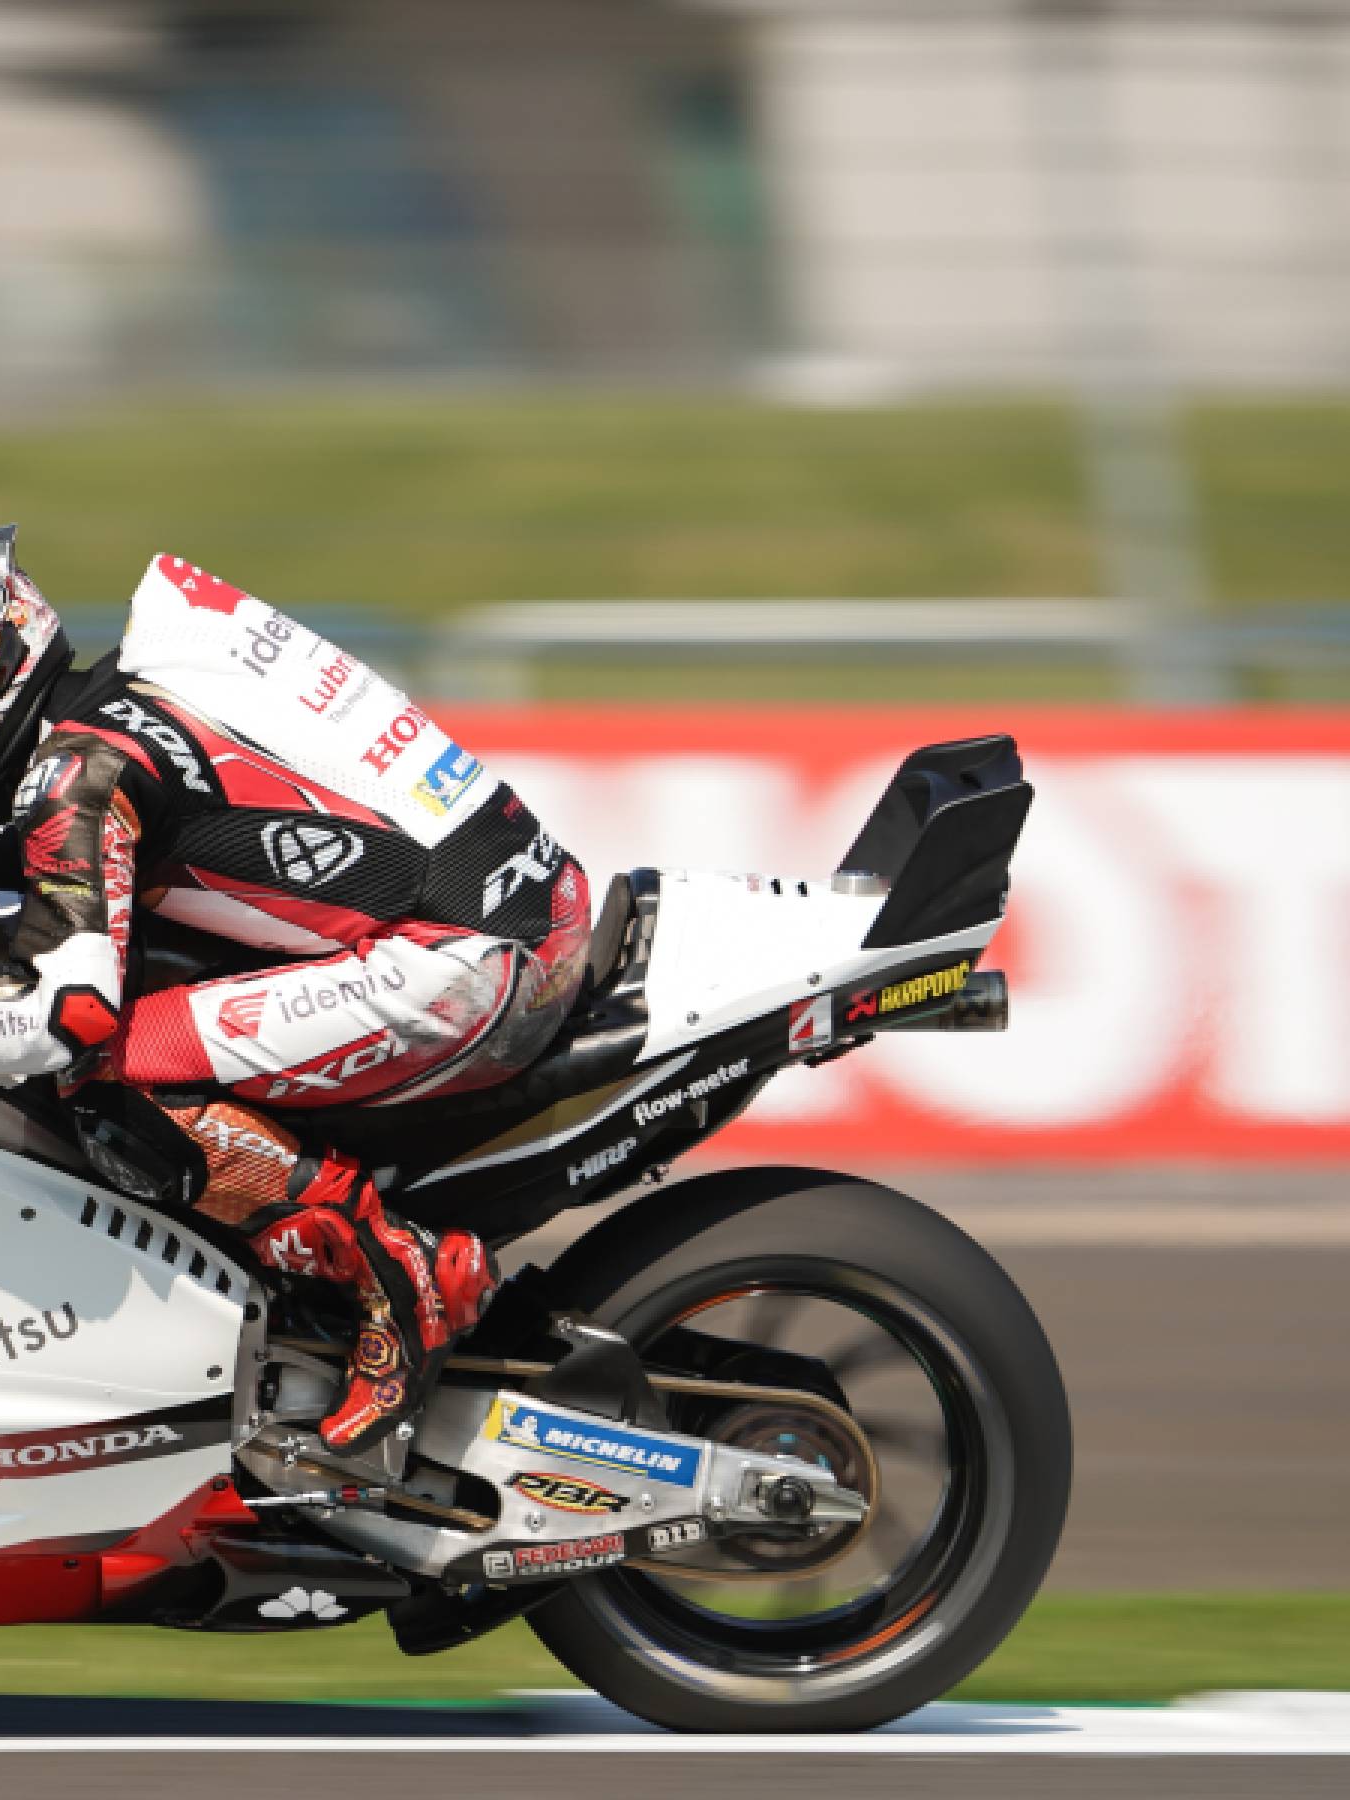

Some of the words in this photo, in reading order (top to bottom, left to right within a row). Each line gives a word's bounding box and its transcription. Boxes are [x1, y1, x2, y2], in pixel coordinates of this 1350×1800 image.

[633, 1056, 750, 1127] flow-meter
[545, 1427, 682, 1473] MICHELIN
[515, 1534, 624, 1567] FEDEGARI
[519, 1553, 626, 1577] GROUP
